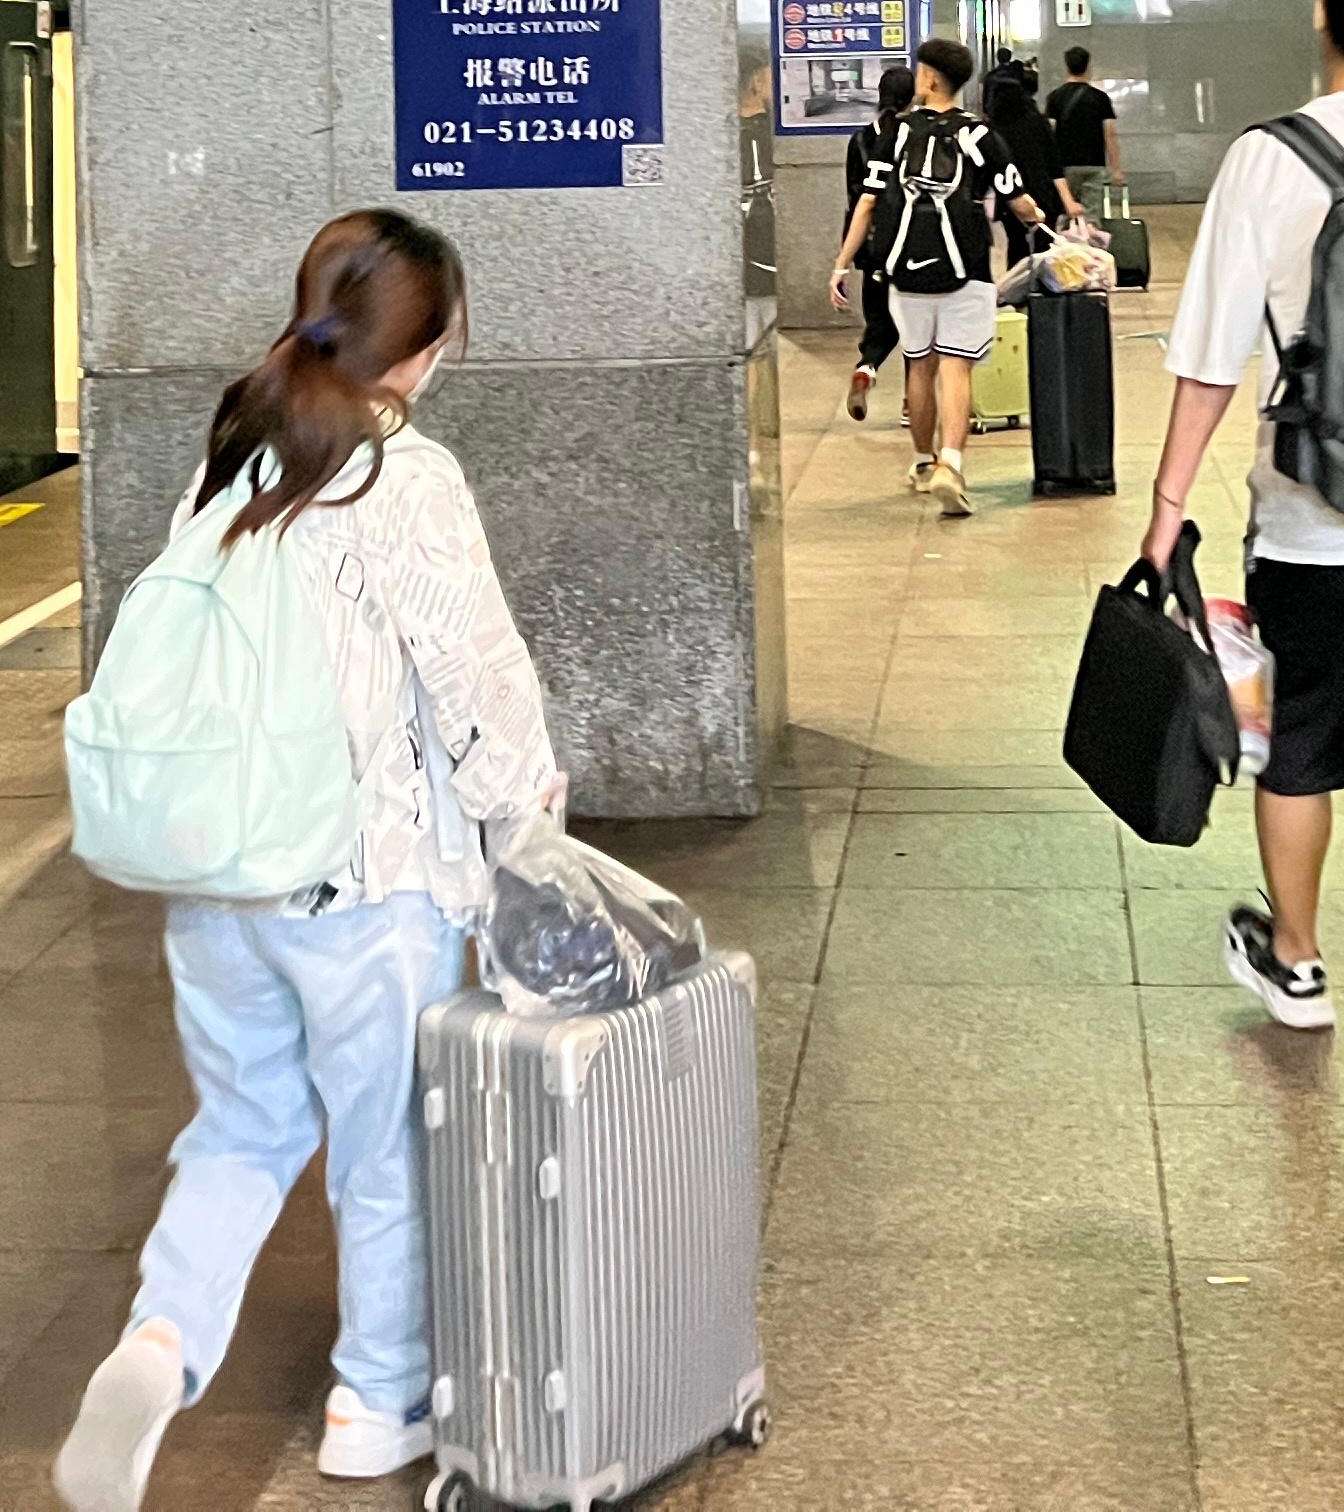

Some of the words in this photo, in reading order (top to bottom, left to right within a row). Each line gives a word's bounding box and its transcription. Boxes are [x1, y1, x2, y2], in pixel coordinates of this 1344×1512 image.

[452, 21, 518, 35] POLICE
[520, 20, 601, 34] STATION
[463, 56, 591, 88] 报警电话
[477, 91, 541, 105] ALARM
[543, 91, 578, 104] TEL
[423, 118, 635, 144] 021-51234408
[411, 161, 466, 178] 61902
